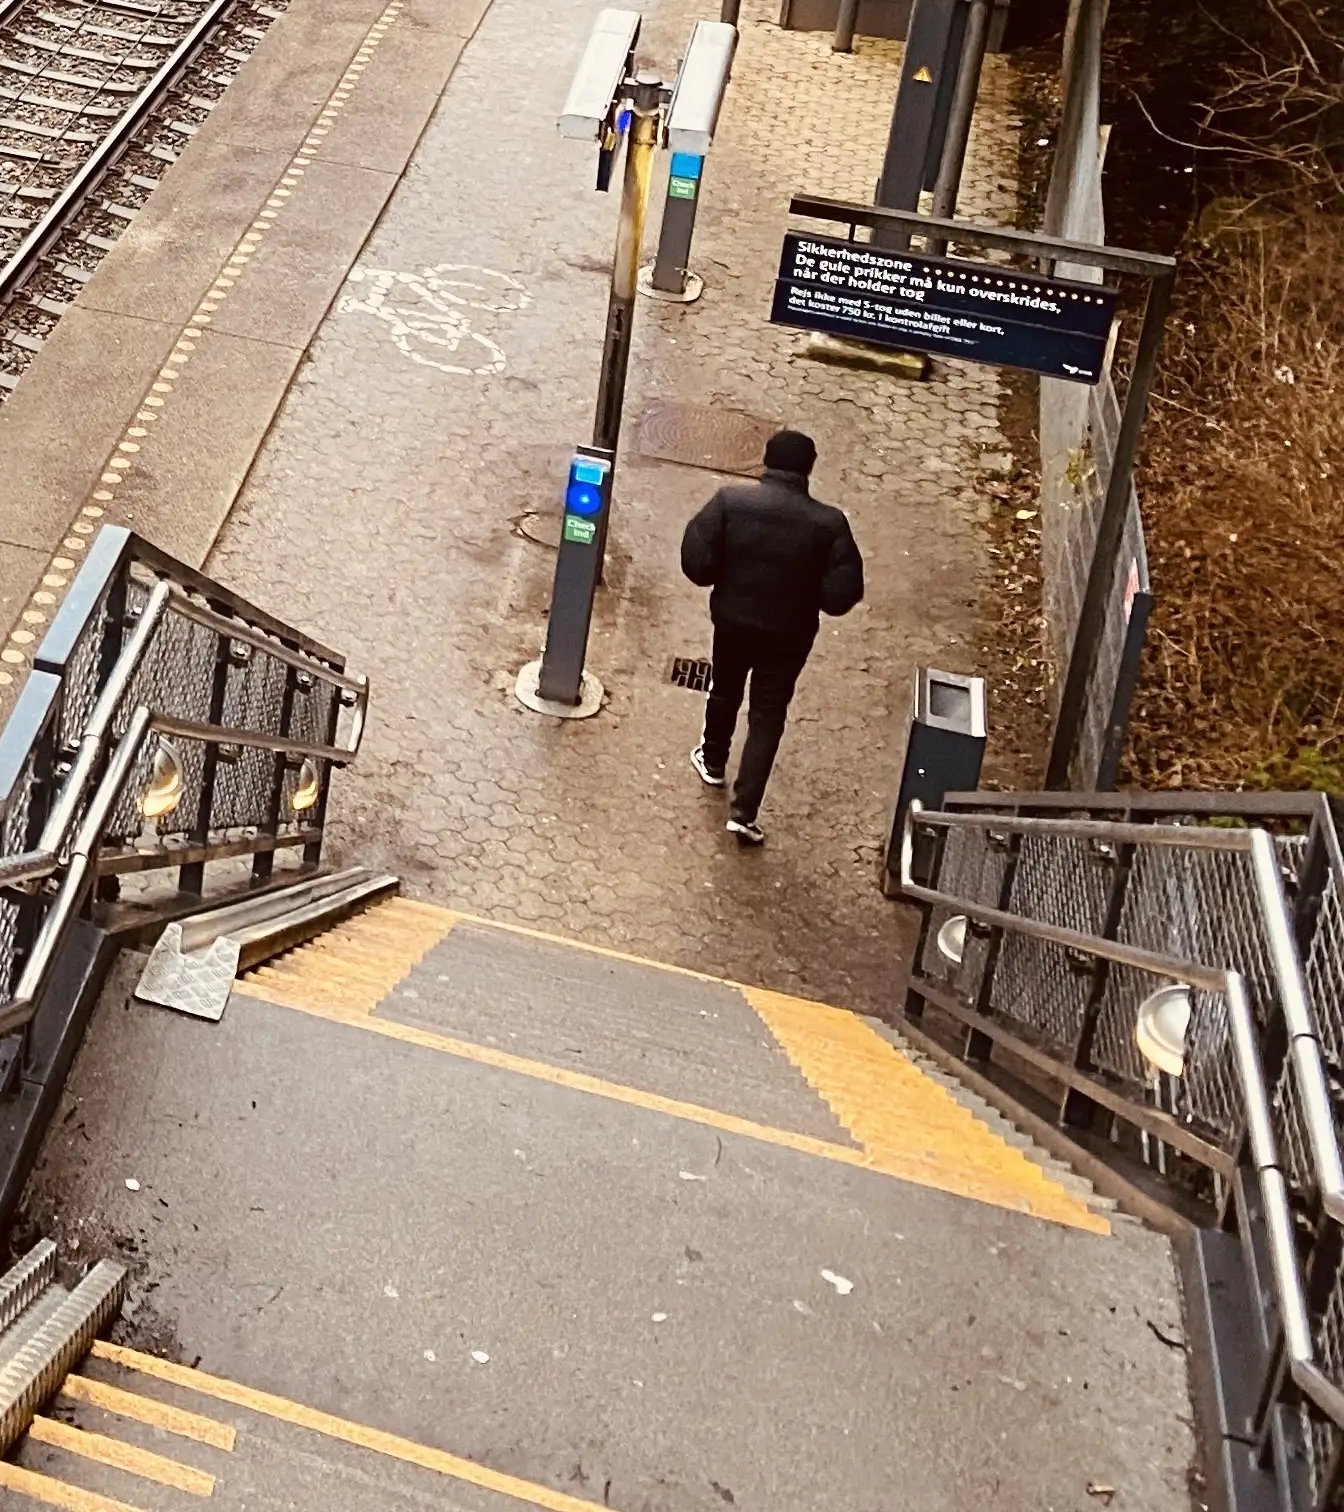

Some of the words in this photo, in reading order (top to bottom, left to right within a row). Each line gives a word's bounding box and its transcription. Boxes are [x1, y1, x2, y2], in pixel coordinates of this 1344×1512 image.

[797, 240, 913, 272] Sikkerhedszone
[793, 267, 819, 280] når
[820, 271, 846, 285] der
[848, 276, 897, 294] holder
[899, 286, 925, 303] tog
[795, 253, 816, 268] De
[819, 259, 851, 274] gule
[853, 266, 908, 284] prikker
[910, 276, 933, 289] må
[937, 280, 966, 295] kun
[968, 287, 1062, 314] overskrides,
[788, 295, 806, 306] det
[808, 299, 841, 313] koster
[842, 306, 862, 317] 750
[884, 314, 951, 334] kontrolafgift
[790, 286, 812, 299] Rejs
[814, 291, 836, 303] ikke
[838, 296, 862, 307] med
[863, 300, 893, 314] S-tog
[894, 308, 921, 319] uden
[923, 311, 951, 325] billet
[953, 318, 978, 329] eller
[566, 518, 596, 531] Check
